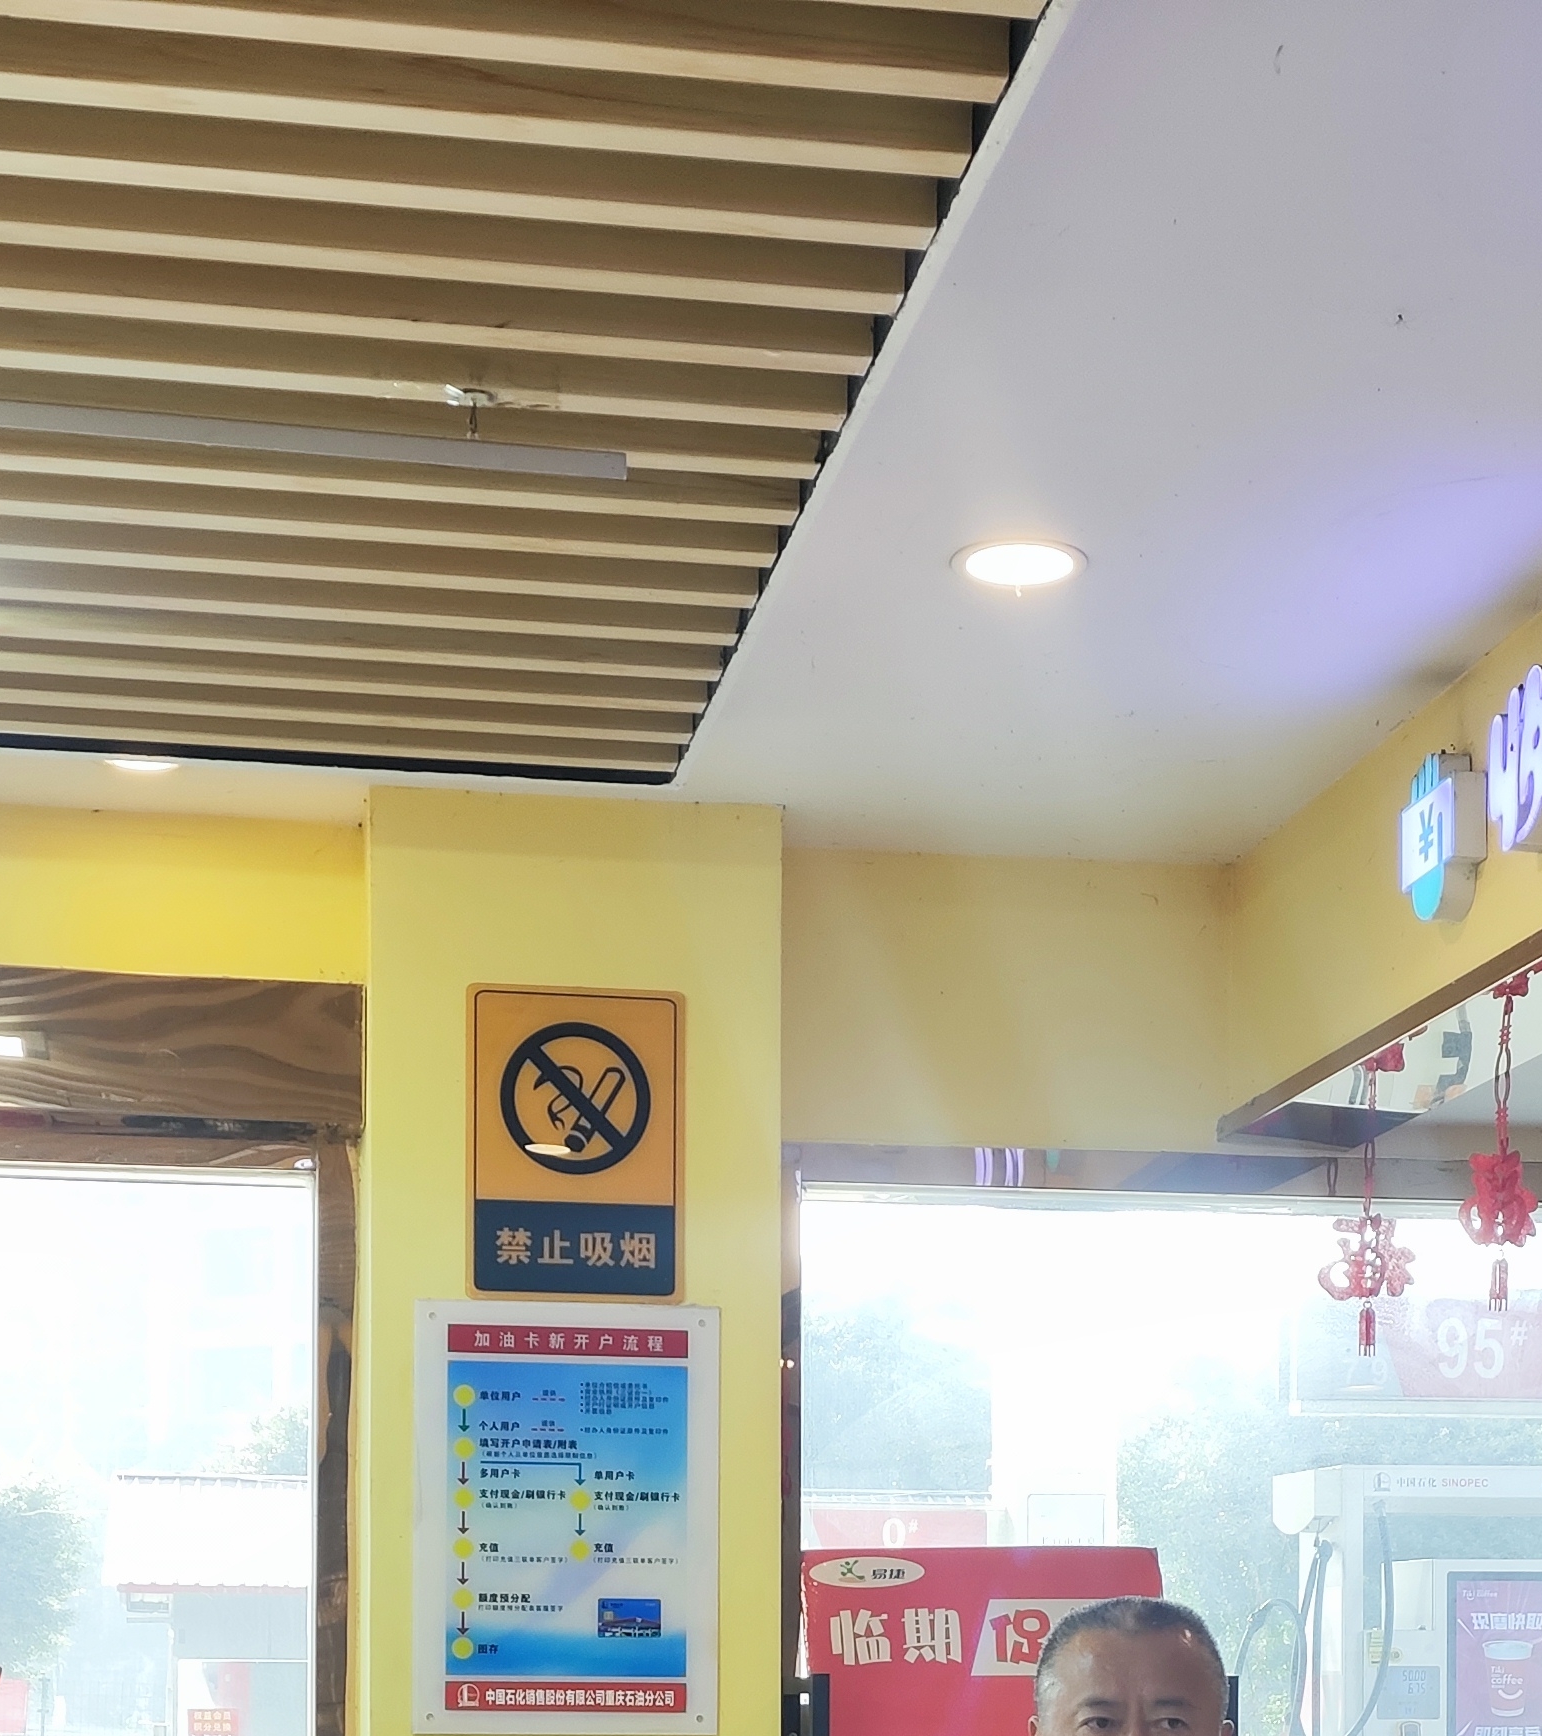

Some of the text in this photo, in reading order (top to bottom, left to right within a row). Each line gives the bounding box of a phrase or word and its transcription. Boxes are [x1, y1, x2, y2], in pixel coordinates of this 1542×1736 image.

[496, 1227, 657, 1270] 禁止吸烟
[474, 1330, 665, 1352] 加油卡新开户流程
[479, 1391, 521, 1401] 单位用户
[479, 1421, 520, 1432] 个人用户
[479, 1438, 578, 1450] 填写开户申请表/附表
[480, 1468, 635, 1481] 多用户卡 单用户卡
[1397, 1477, 1438, 1489] 中国石化
[1442, 1478, 1489, 1488] SINOPEC
[479, 1489, 680, 1502] 支付现金/刷银行卡 支付现金/刷银行卡
[479, 1543, 614, 1553] 充值 充值
[871, 1569, 906, 1580] 易捷
[478, 1593, 531, 1604] 额度预分配
[1491, 1674, 1523, 1684] coffee
[485, 1687, 675, 1707] 中国石化销售股份有限公司重庆石油分公司
